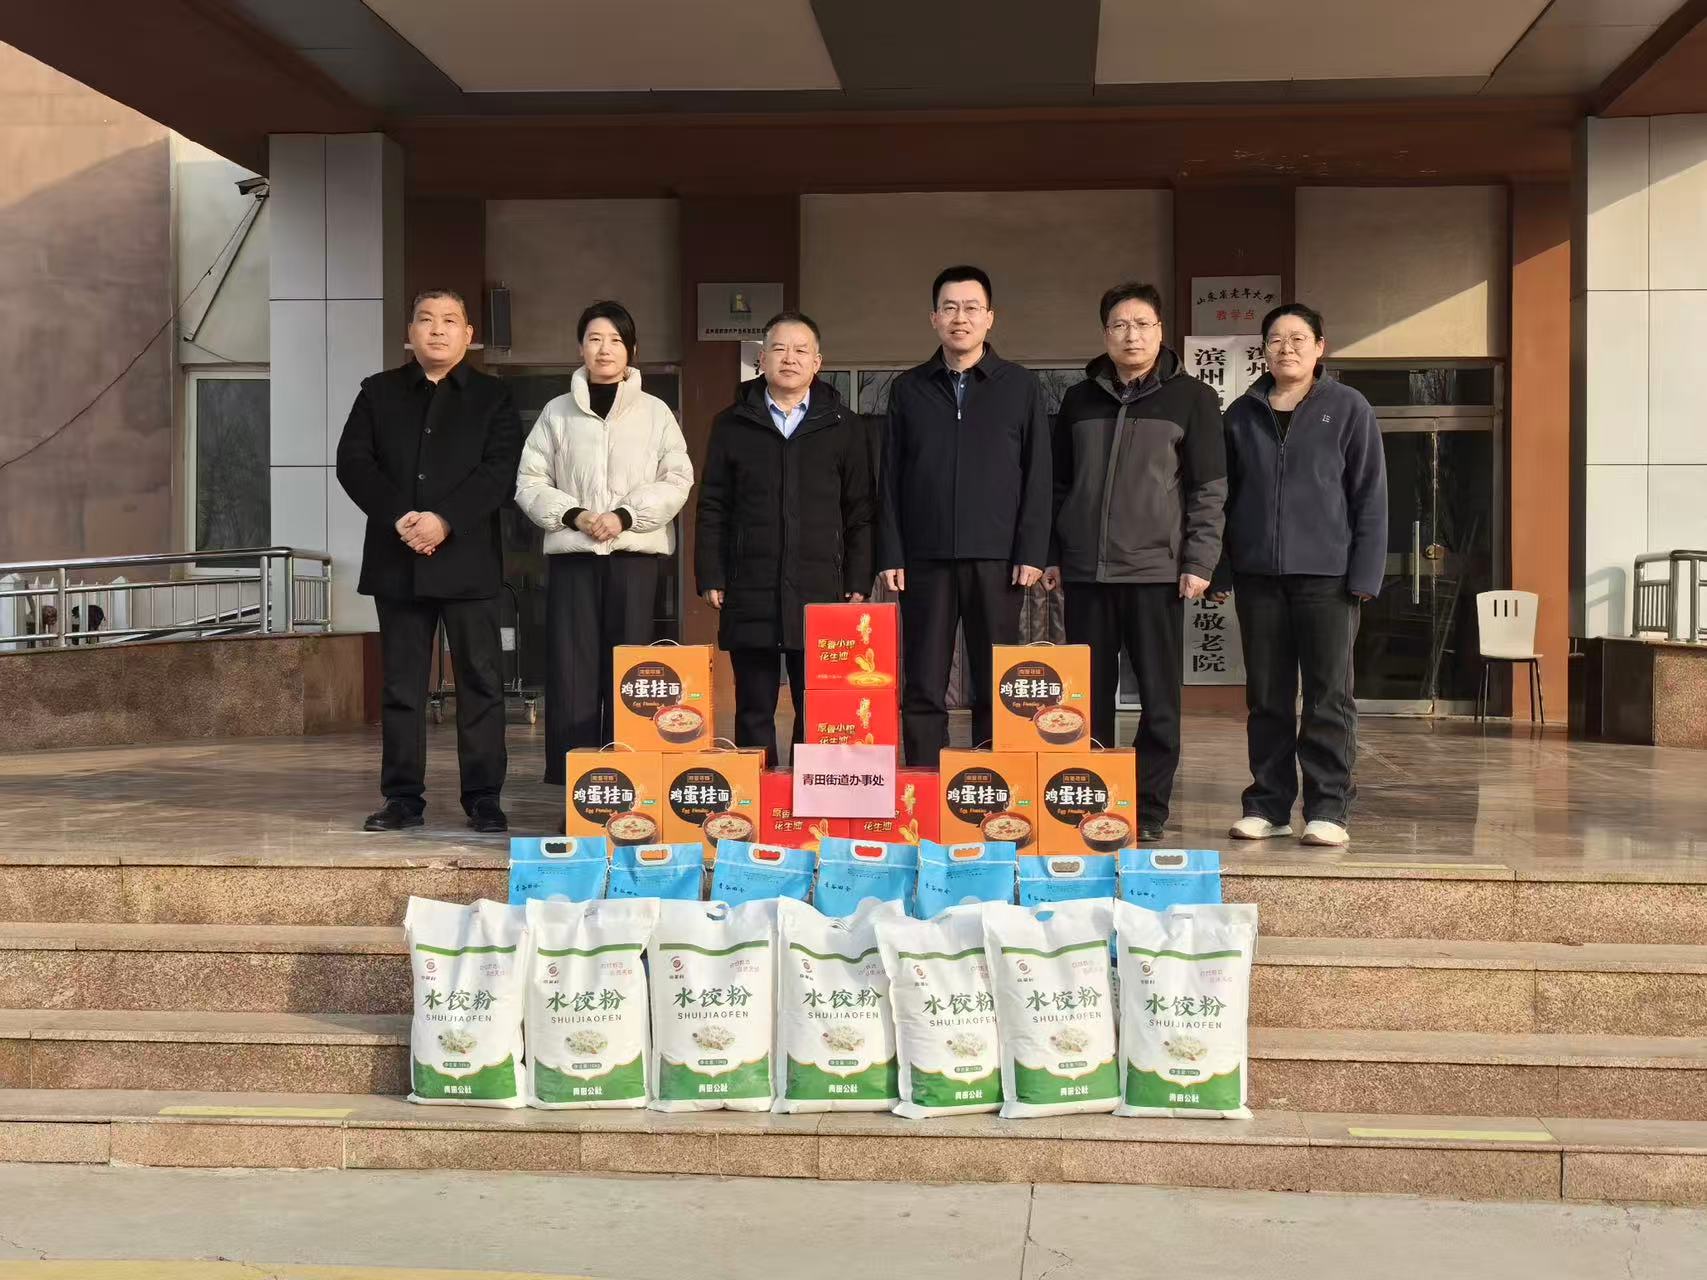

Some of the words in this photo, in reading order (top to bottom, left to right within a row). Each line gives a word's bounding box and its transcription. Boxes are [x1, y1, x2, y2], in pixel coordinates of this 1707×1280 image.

[621, 678, 680, 698] 鸡蛋挂面
[1000, 678, 1060, 698] 鸡蛋挂面
[802, 773, 885, 787] 青田街道办事处
[573, 785, 633, 805] 鸡蛋挂面
[670, 785, 729, 805] 鸡蛋挂面
[947, 785, 1008, 805] 鸡蛋挂面
[1045, 785, 1106, 806] 鸡蛋挂面
[772, 807, 792, 819] 原香
[422, 988, 498, 1010] 水饺粉
[546, 988, 627, 1012] 水饺粉
[672, 984, 753, 1008] 水饺粉
[802, 986, 883, 1009] 水饺粉
[922, 991, 994, 1015] 水饺粉
[1025, 985, 1102, 1011] 水饺粉
[1144, 992, 1227, 1017] 水饺粉
[425, 1013, 492, 1022] SHUIJIAOFEN
[551, 1014, 622, 1024] SHUIJIAOFEN
[677, 1011, 749, 1020] SHUIJIAOFEN
[807, 1011, 879, 1019] SHUIJIAOFEN
[1032, 1011, 1102, 1023] SHUIJIAOFEN
[1149, 1018, 1223, 1029] SHUIJIAOFEN
